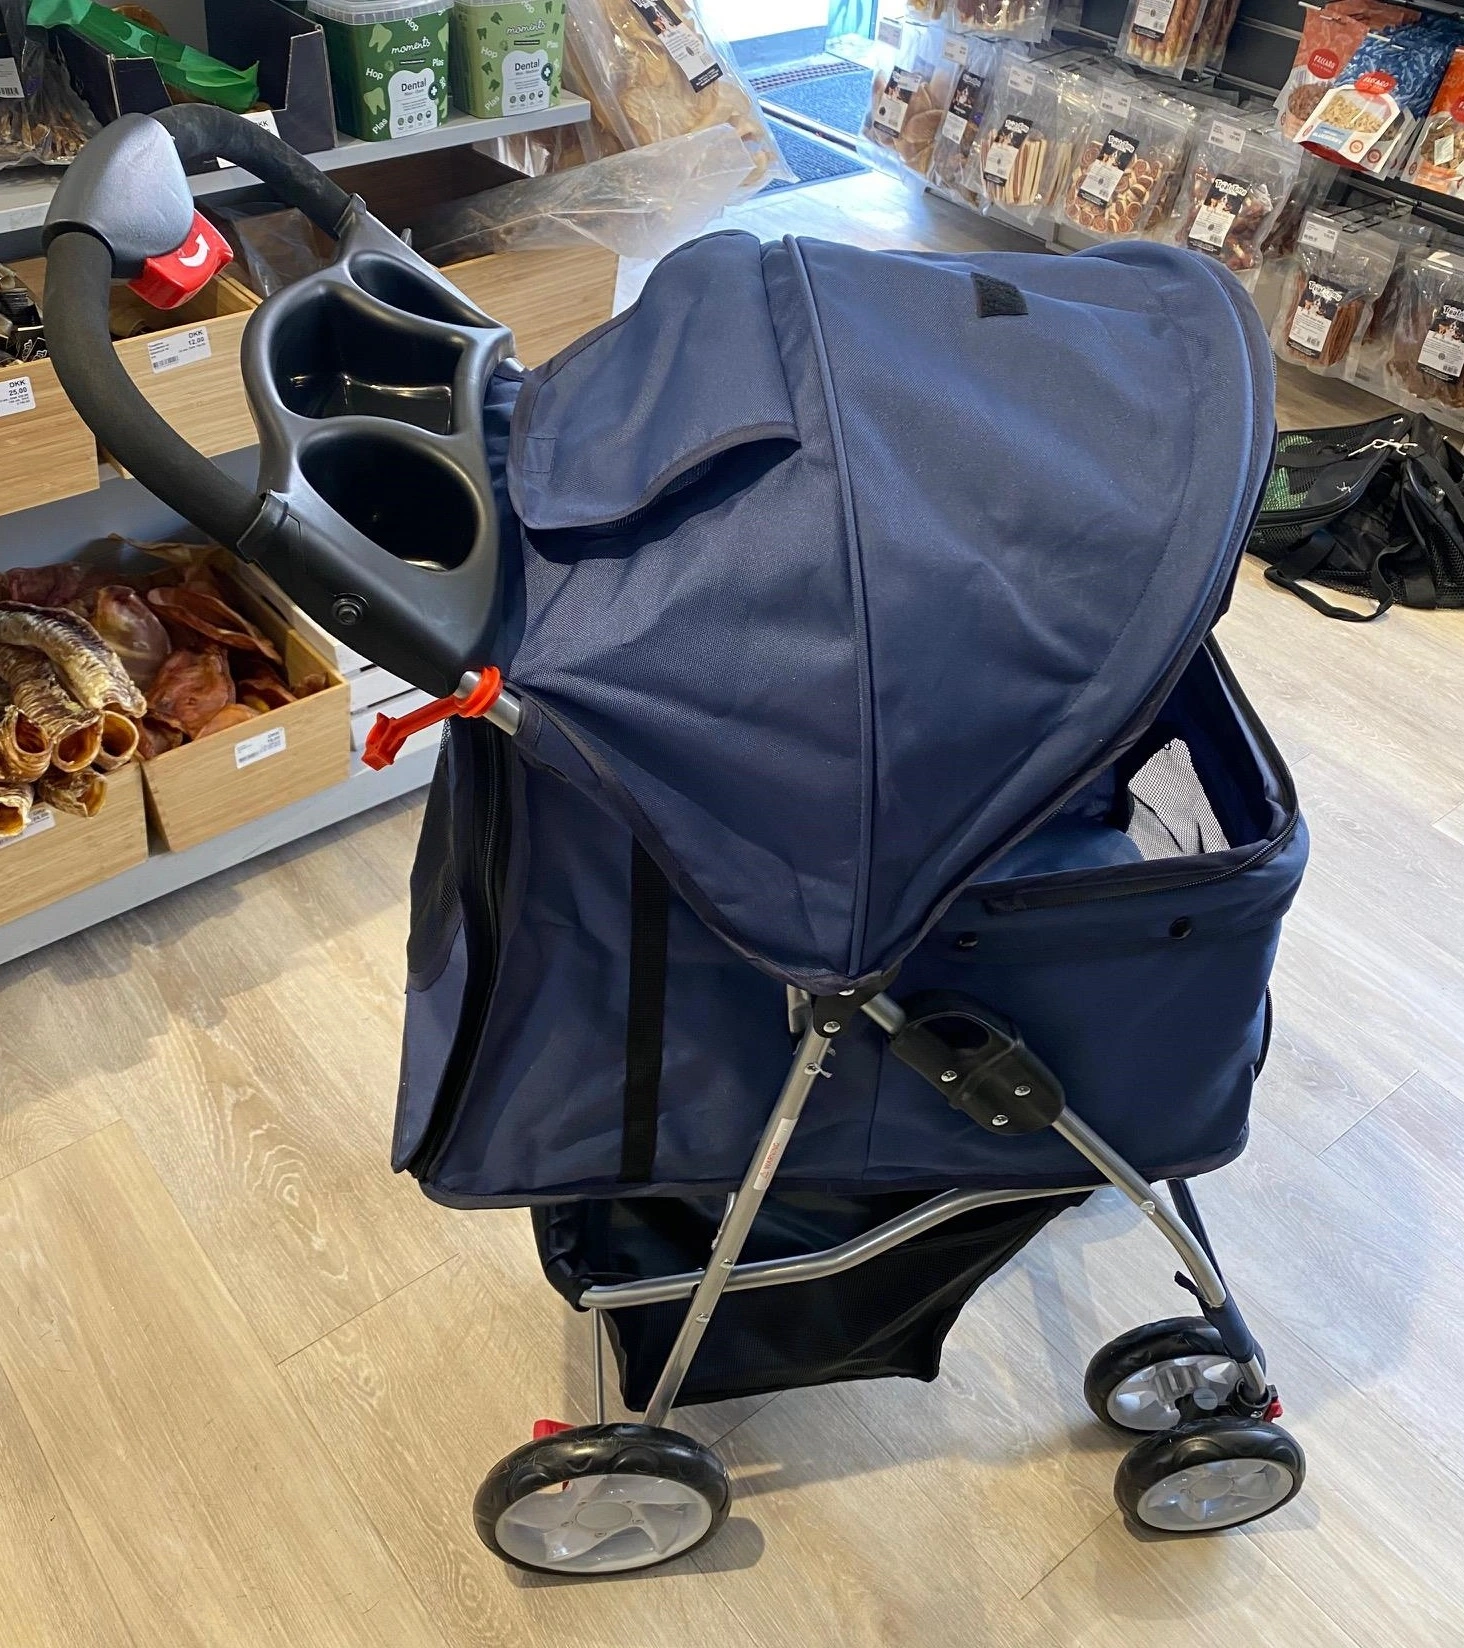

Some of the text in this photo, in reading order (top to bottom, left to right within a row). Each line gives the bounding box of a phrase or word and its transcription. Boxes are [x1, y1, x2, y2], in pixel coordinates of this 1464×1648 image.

[391, 36, 431, 54] moments
[481, 46, 498, 59] Hop
[515, 59, 540, 71] Dental
[366, 68, 384, 80] Hop
[401, 78, 427, 92] Dental
[372, 118, 388, 134] Plas
[8, 379, 26, 388] DKK
